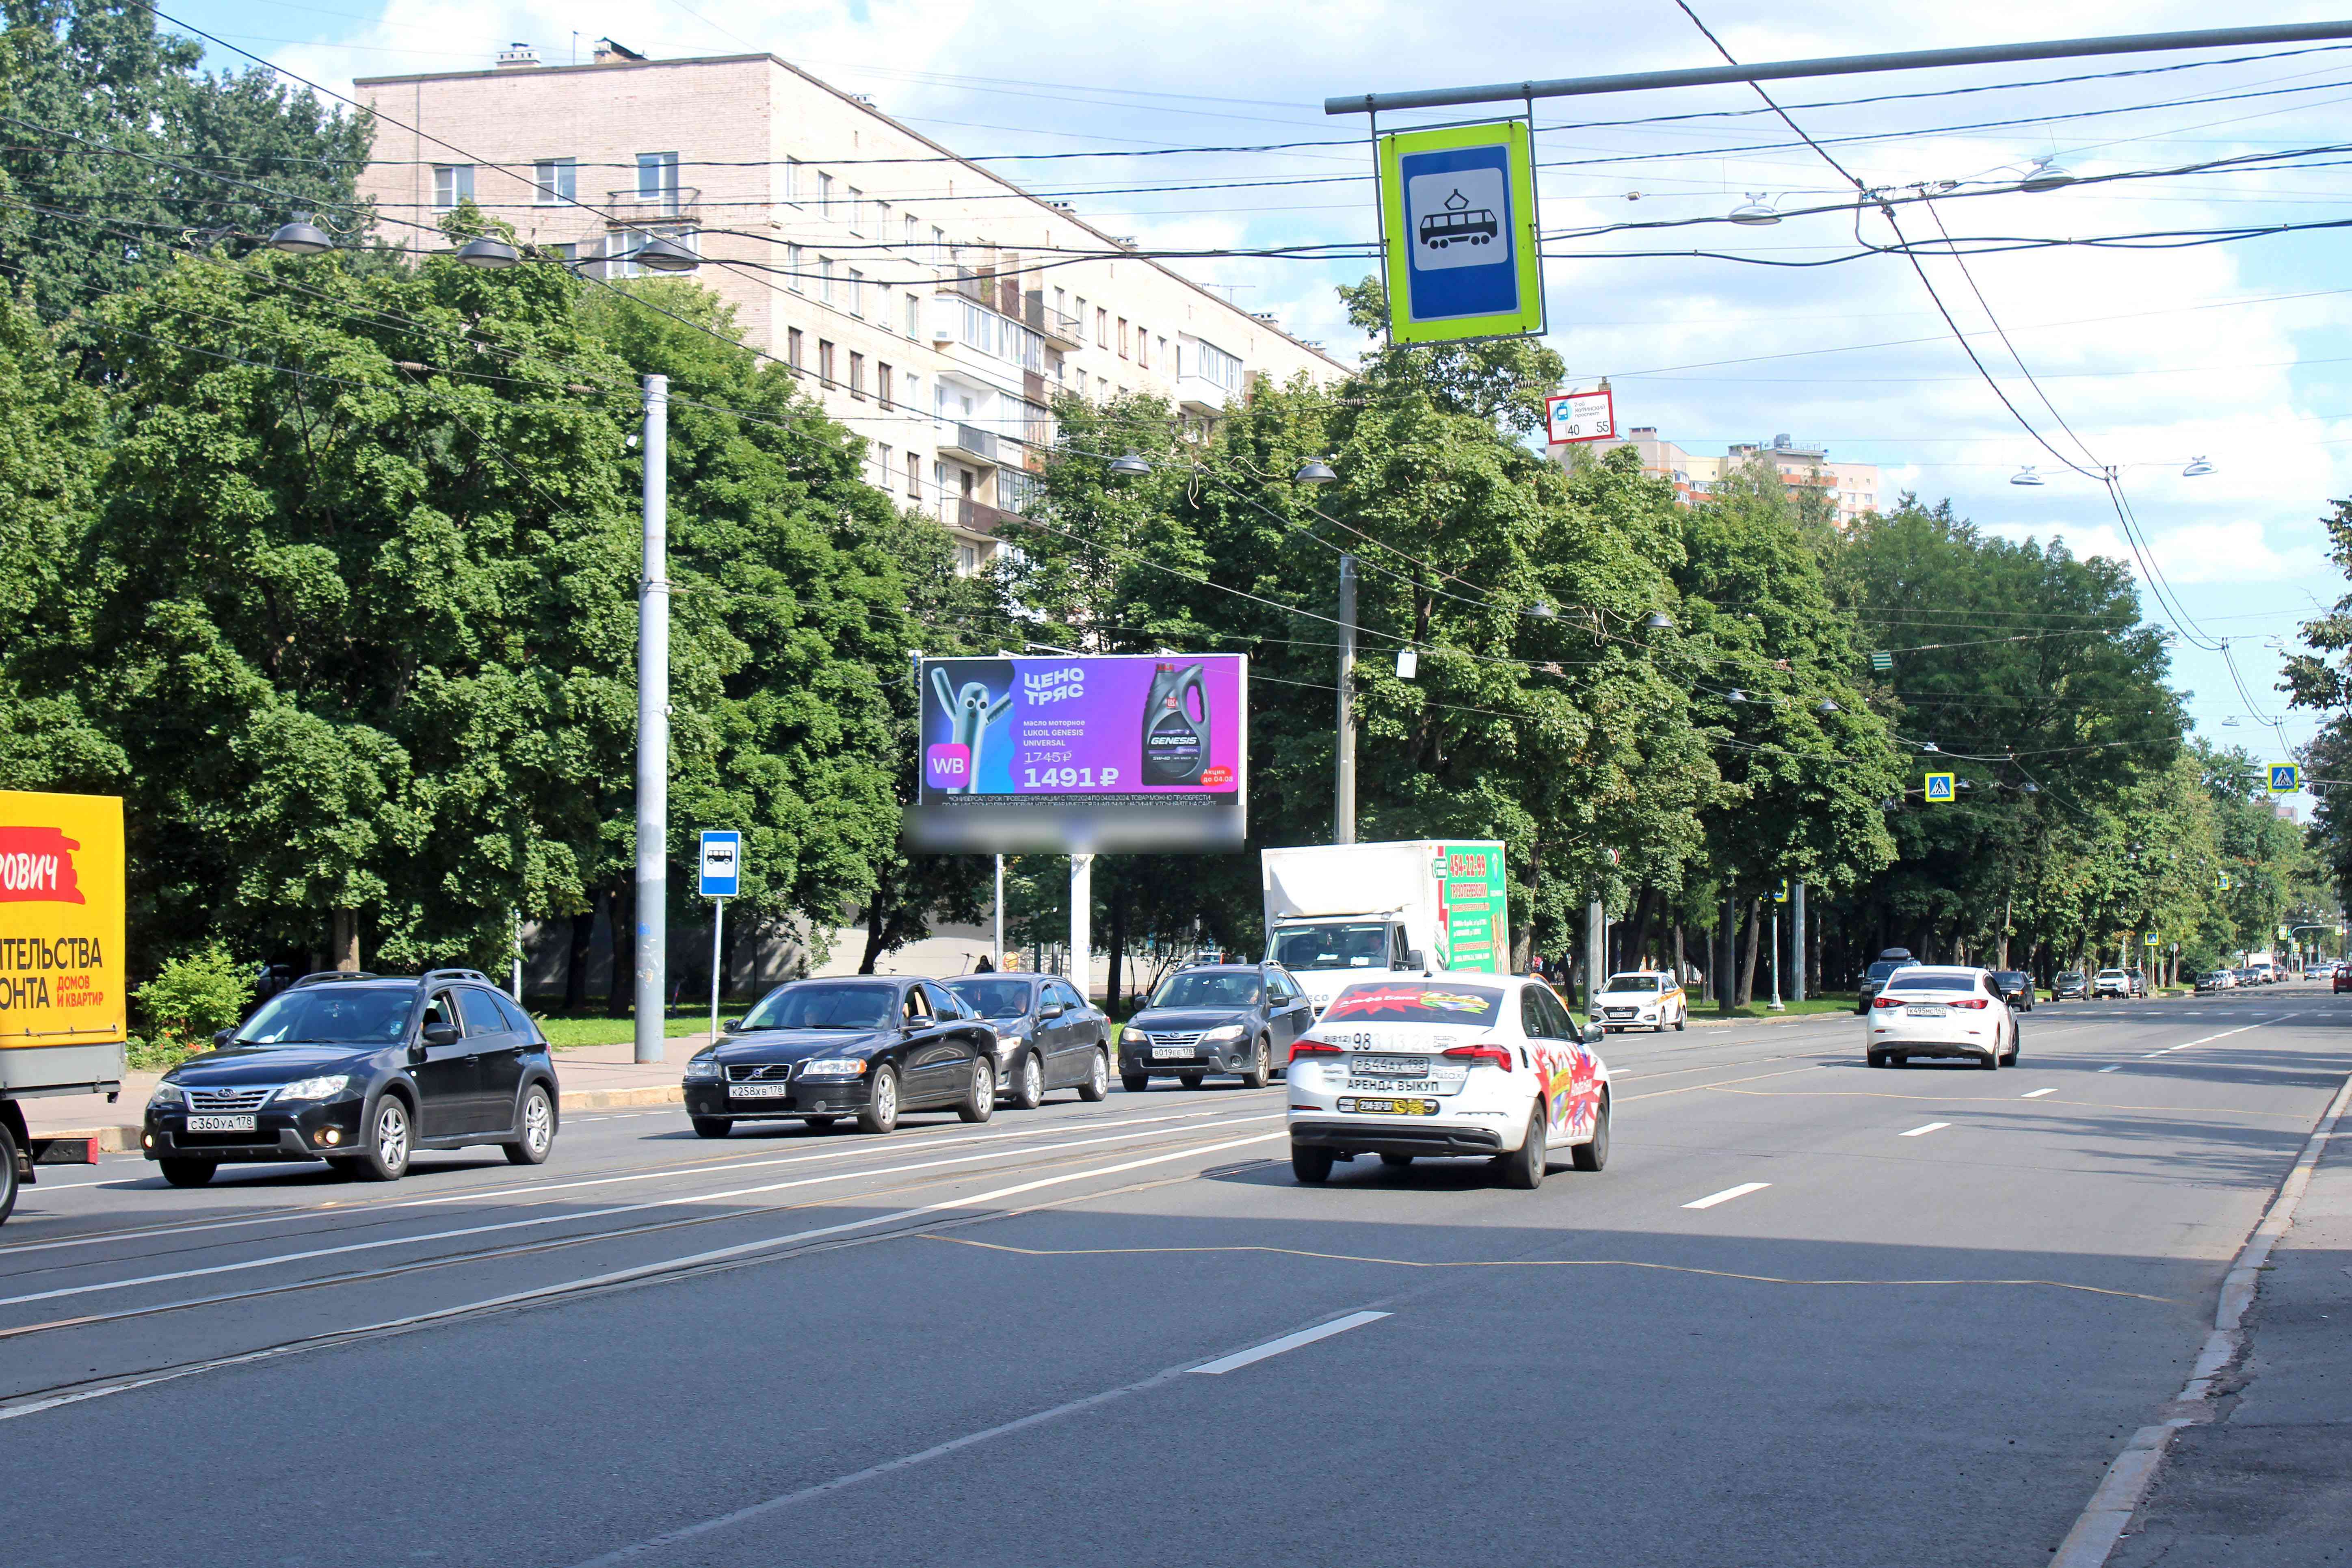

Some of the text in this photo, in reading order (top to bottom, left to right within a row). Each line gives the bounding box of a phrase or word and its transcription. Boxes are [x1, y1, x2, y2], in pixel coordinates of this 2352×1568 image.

[1568, 424, 1580, 436] 40
[1597, 421, 1609, 433] 55
[1024, 668, 1084, 691] ЦЕНО
[1024, 683, 1084, 705] ТРЯС
[1151, 737, 1197, 745] GENESIS
[933, 758, 964, 774] WB
[1450, 854, 1486, 877] 454-22-99
[56, 975, 90, 993] ДОМОВ
[56, 991, 104, 1008] И КВАРТИР
[732, 1087, 767, 1096] К258ХВ
[1347, 1079, 1439, 1092] АРЕНДА ВЫКУП
[191, 1116, 252, 1129] С360УА 178
